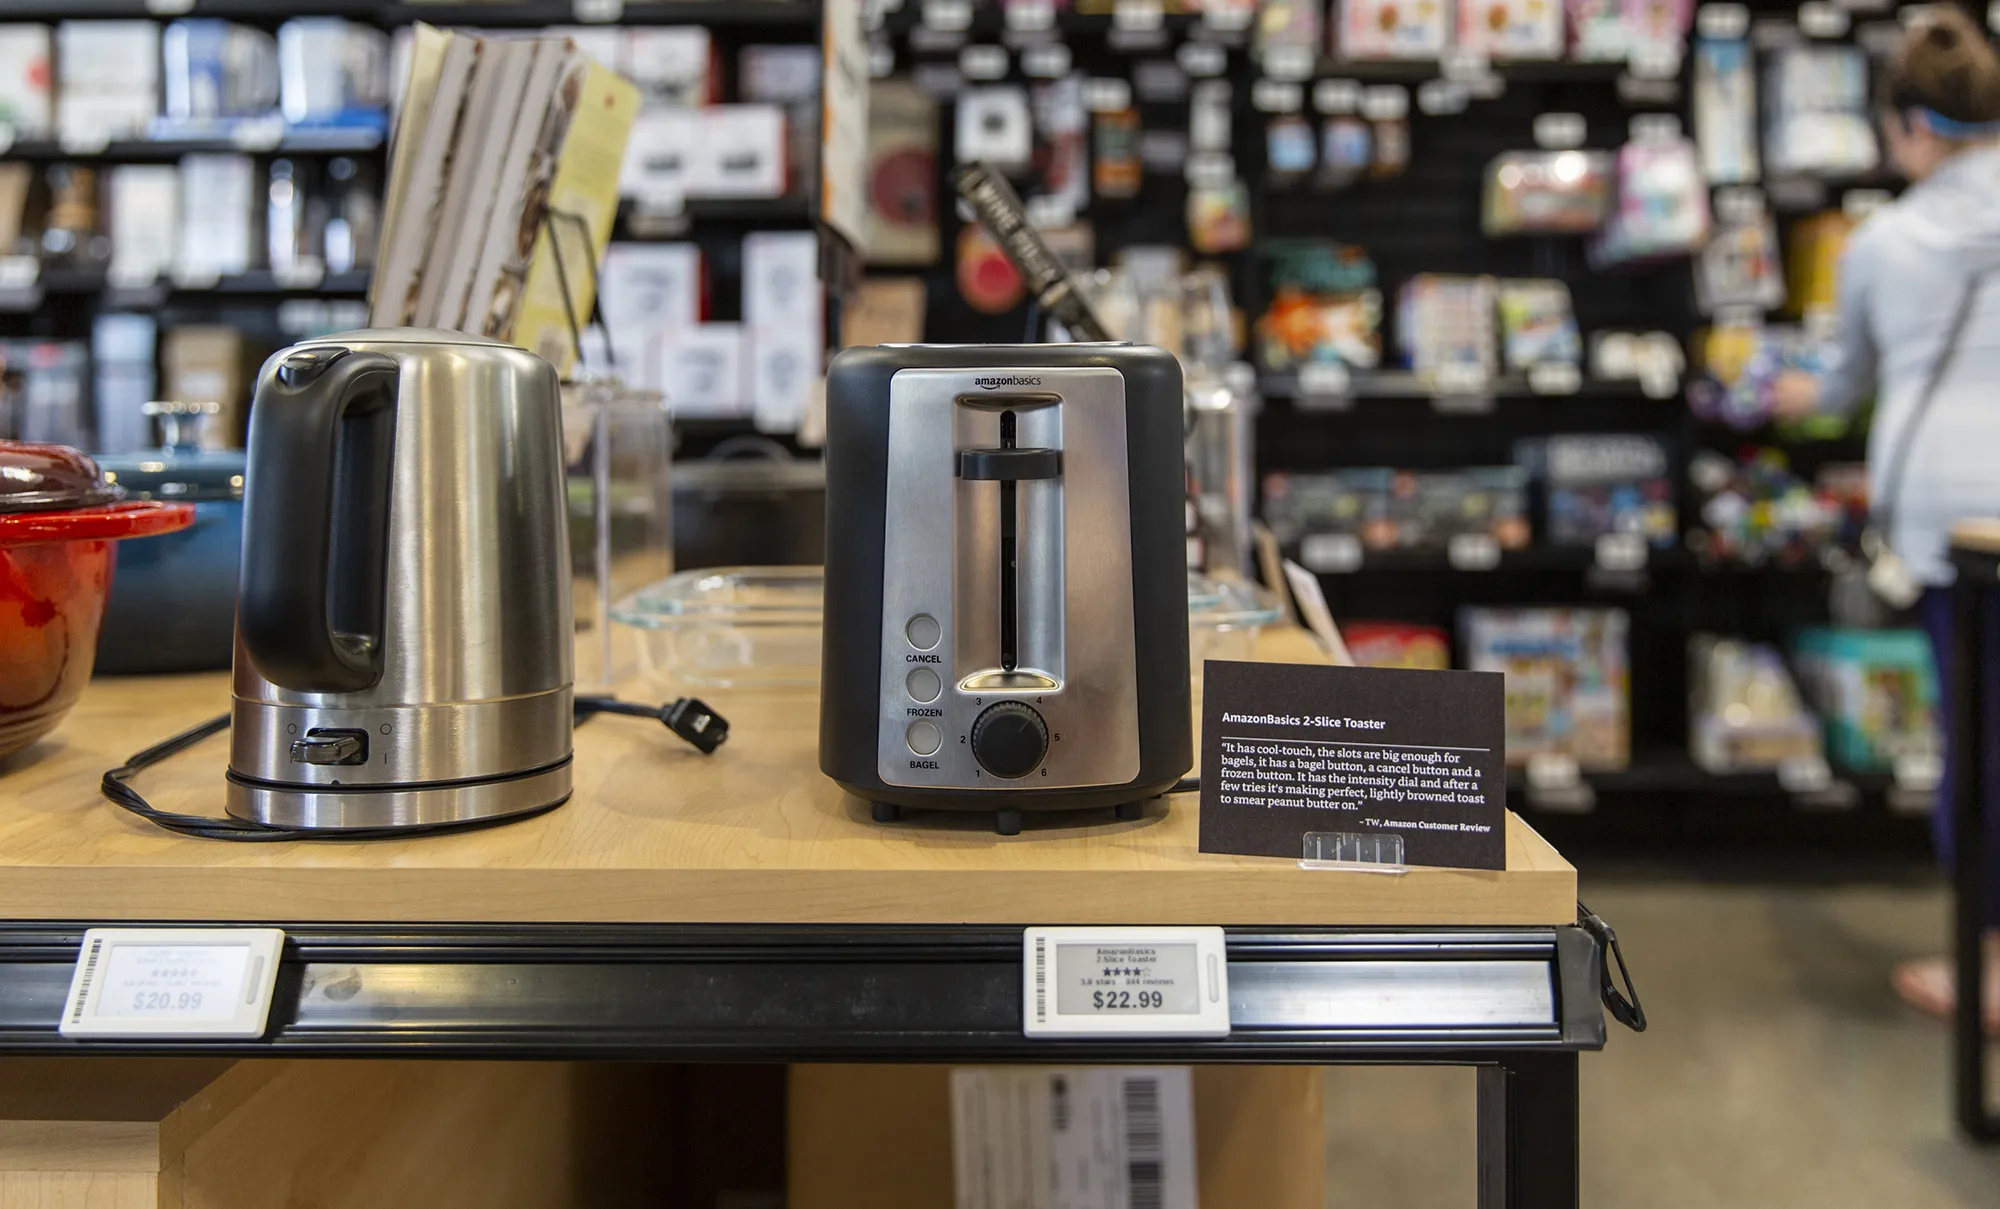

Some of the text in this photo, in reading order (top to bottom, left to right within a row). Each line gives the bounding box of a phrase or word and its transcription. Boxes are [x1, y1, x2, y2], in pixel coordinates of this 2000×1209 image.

[974, 375, 1042, 387] amazonbasics
[905, 654, 942, 664] CANCEL
[975, 696, 1043, 706] 3 4
[906, 708, 943, 717] FROZEN
[1222, 712, 1386, 730] AmazonBasics 2-Slice Toaster
[960, 733, 1060, 744] 2 5
[1221, 742, 1460, 764] “It has cool-touch, the slots are big enough for
[909, 760, 940, 770] BAGEL
[1221, 755, 1257, 767] bagels,
[1259, 757, 1266, 767] it
[1269, 757, 1287, 768] has
[1297, 759, 1325, 772] bagel
[1327, 760, 1367, 773] button,
[1368, 764, 1375, 772] a
[1376, 763, 1411, 774] cancel
[1412, 764, 1449, 776] button
[1451, 767, 1472, 777] and
[1474, 769, 1481, 777] a
[976, 768, 1047, 778] 1 6
[1221, 767, 1478, 790] frozen button. It has the intensity dial and after a
[1220, 780, 1485, 804] few tries it's making perfect, lightly browned toast
[1220, 794, 1363, 810] to smear peanut butter on.”
[1383, 819, 1417, 828] Amazon
[1418, 821, 1458, 831] Customer
[1459, 823, 1491, 832] Review
[132, 991, 203, 1010] $20.99
[1092, 990, 1163, 1010] $22.99
